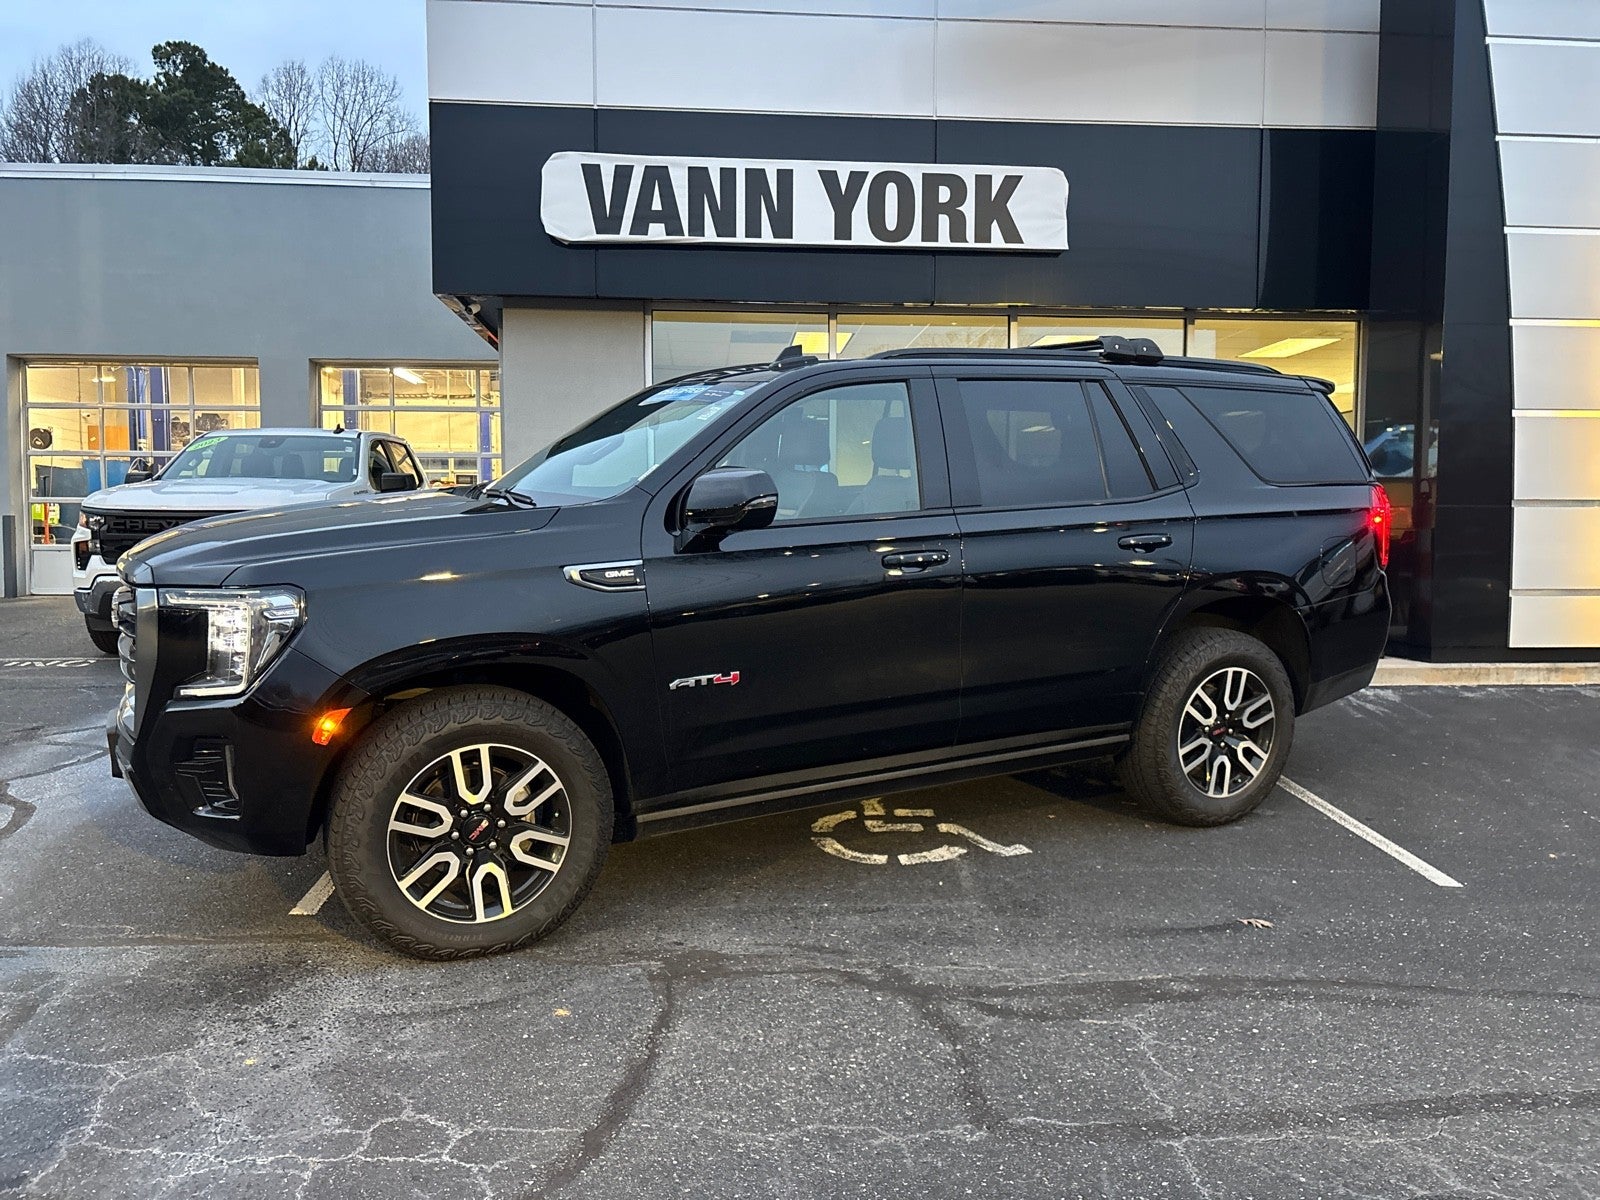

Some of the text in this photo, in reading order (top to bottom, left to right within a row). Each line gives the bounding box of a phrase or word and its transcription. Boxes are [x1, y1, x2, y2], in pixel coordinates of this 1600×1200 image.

[581, 162, 1024, 244] VANN YORK
[110, 518, 187, 529] CHEV
[604, 569, 634, 578] GMC
[669, 671, 740, 691] AT4
[468, 819, 489, 841] GMC
